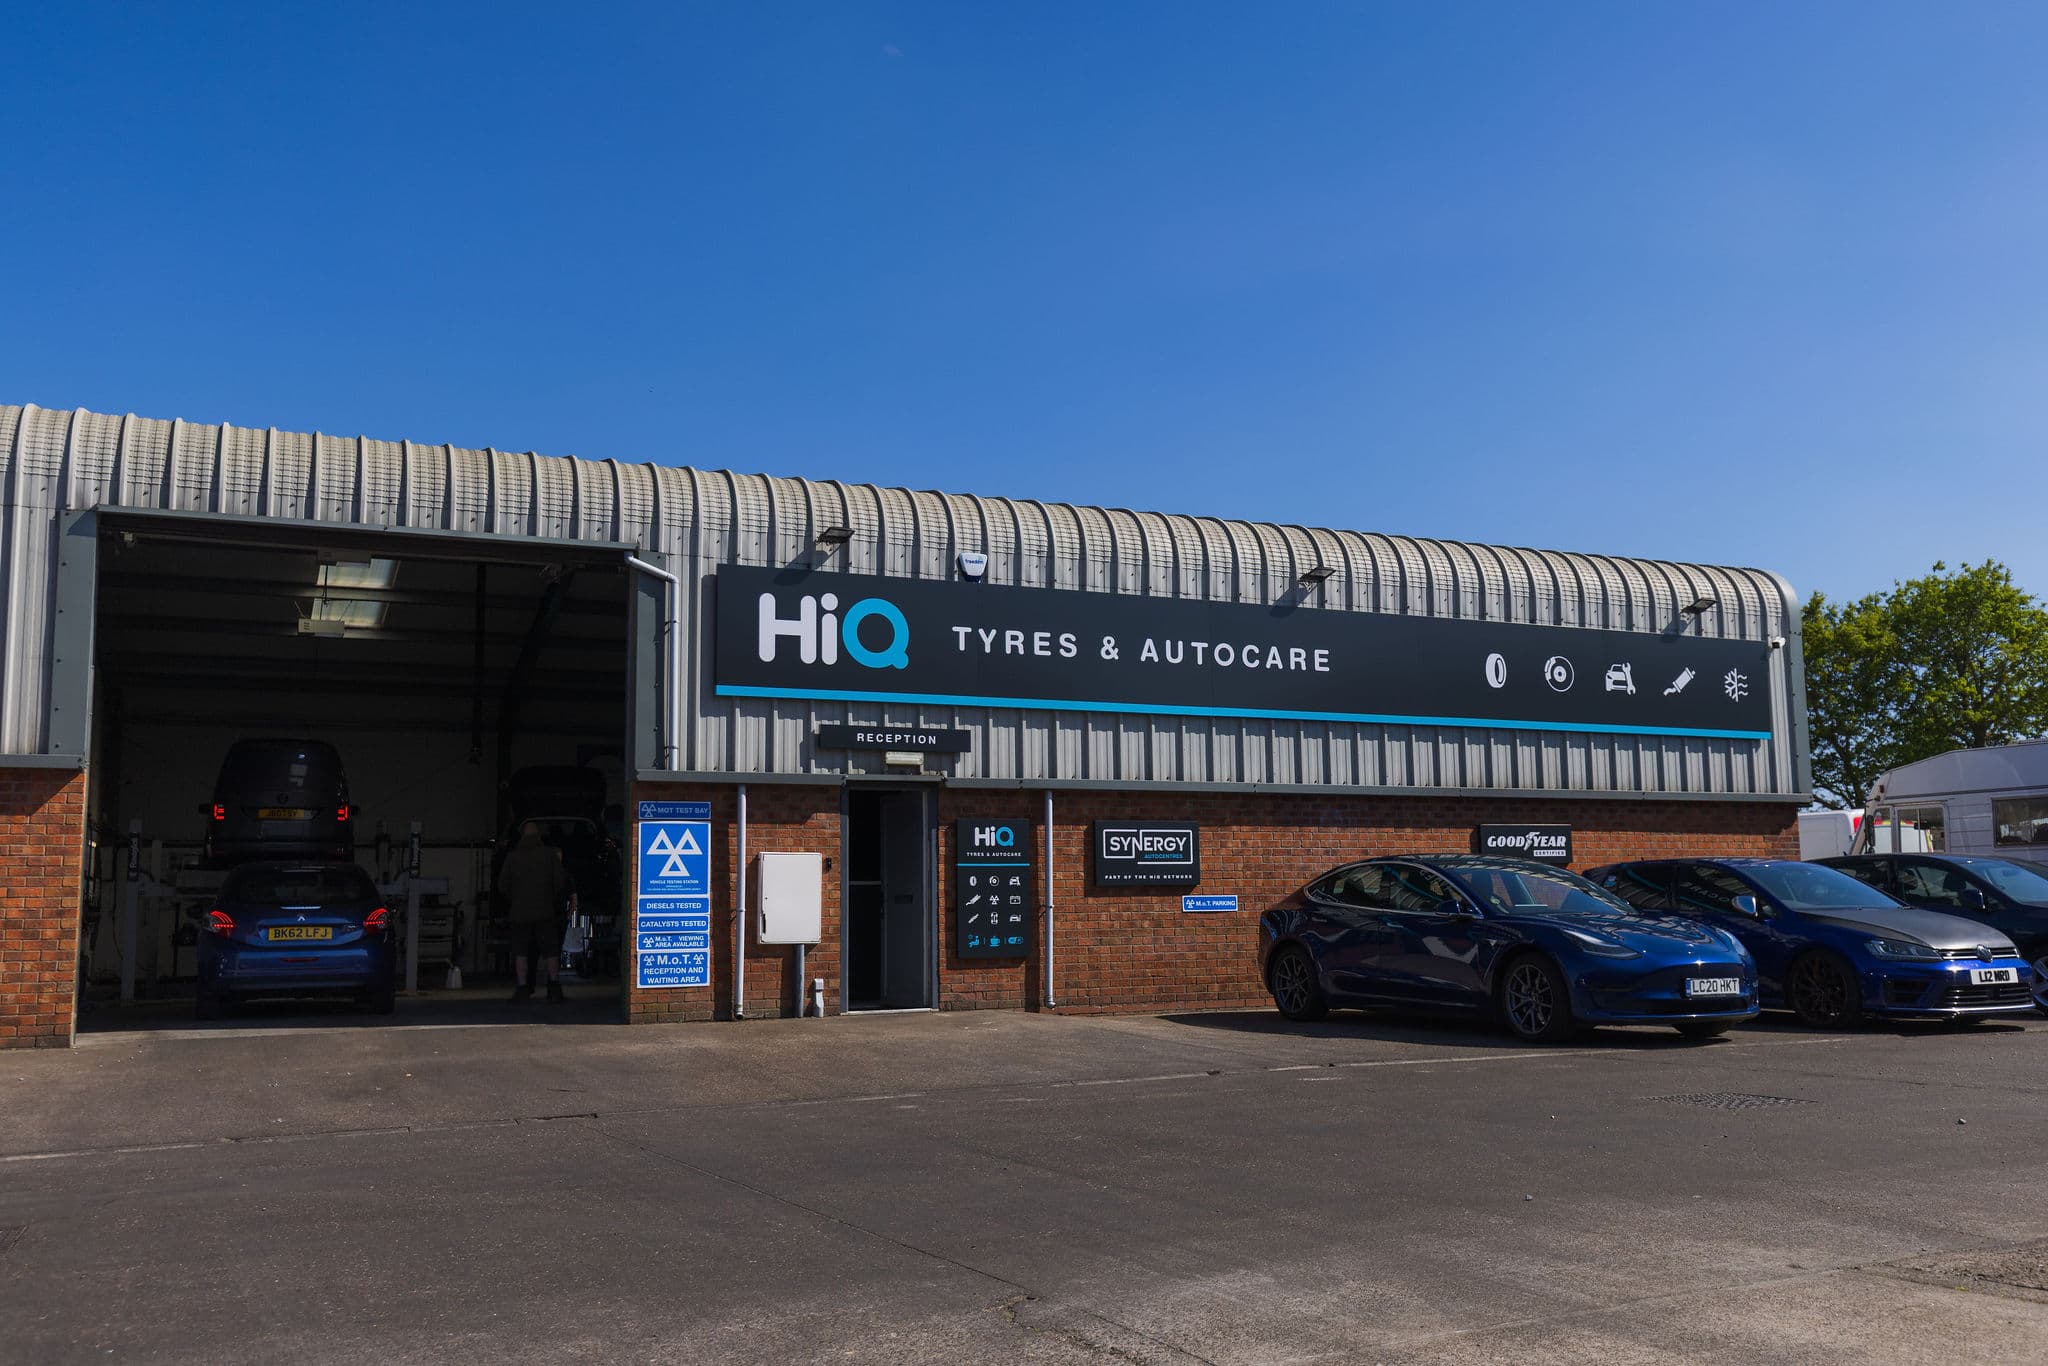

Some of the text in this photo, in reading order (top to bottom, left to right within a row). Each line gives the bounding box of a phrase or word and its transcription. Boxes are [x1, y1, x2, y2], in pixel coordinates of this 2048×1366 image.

[758, 592, 910, 670] HiQ
[952, 626, 1330, 672] TYRES & AUTOCARE
[857, 733, 936, 744] RECEPTION
[974, 826, 1014, 846] HiQ
[1110, 836, 1187, 852] SYNERGY
[274, 928, 328, 938] BK62 LFJ
[657, 954, 692, 965] M.o.T.
[644, 966, 704, 975] RECEPTION AND
[647, 976, 679, 984] WAITING
[1692, 979, 1738, 993] LC20 HKT
